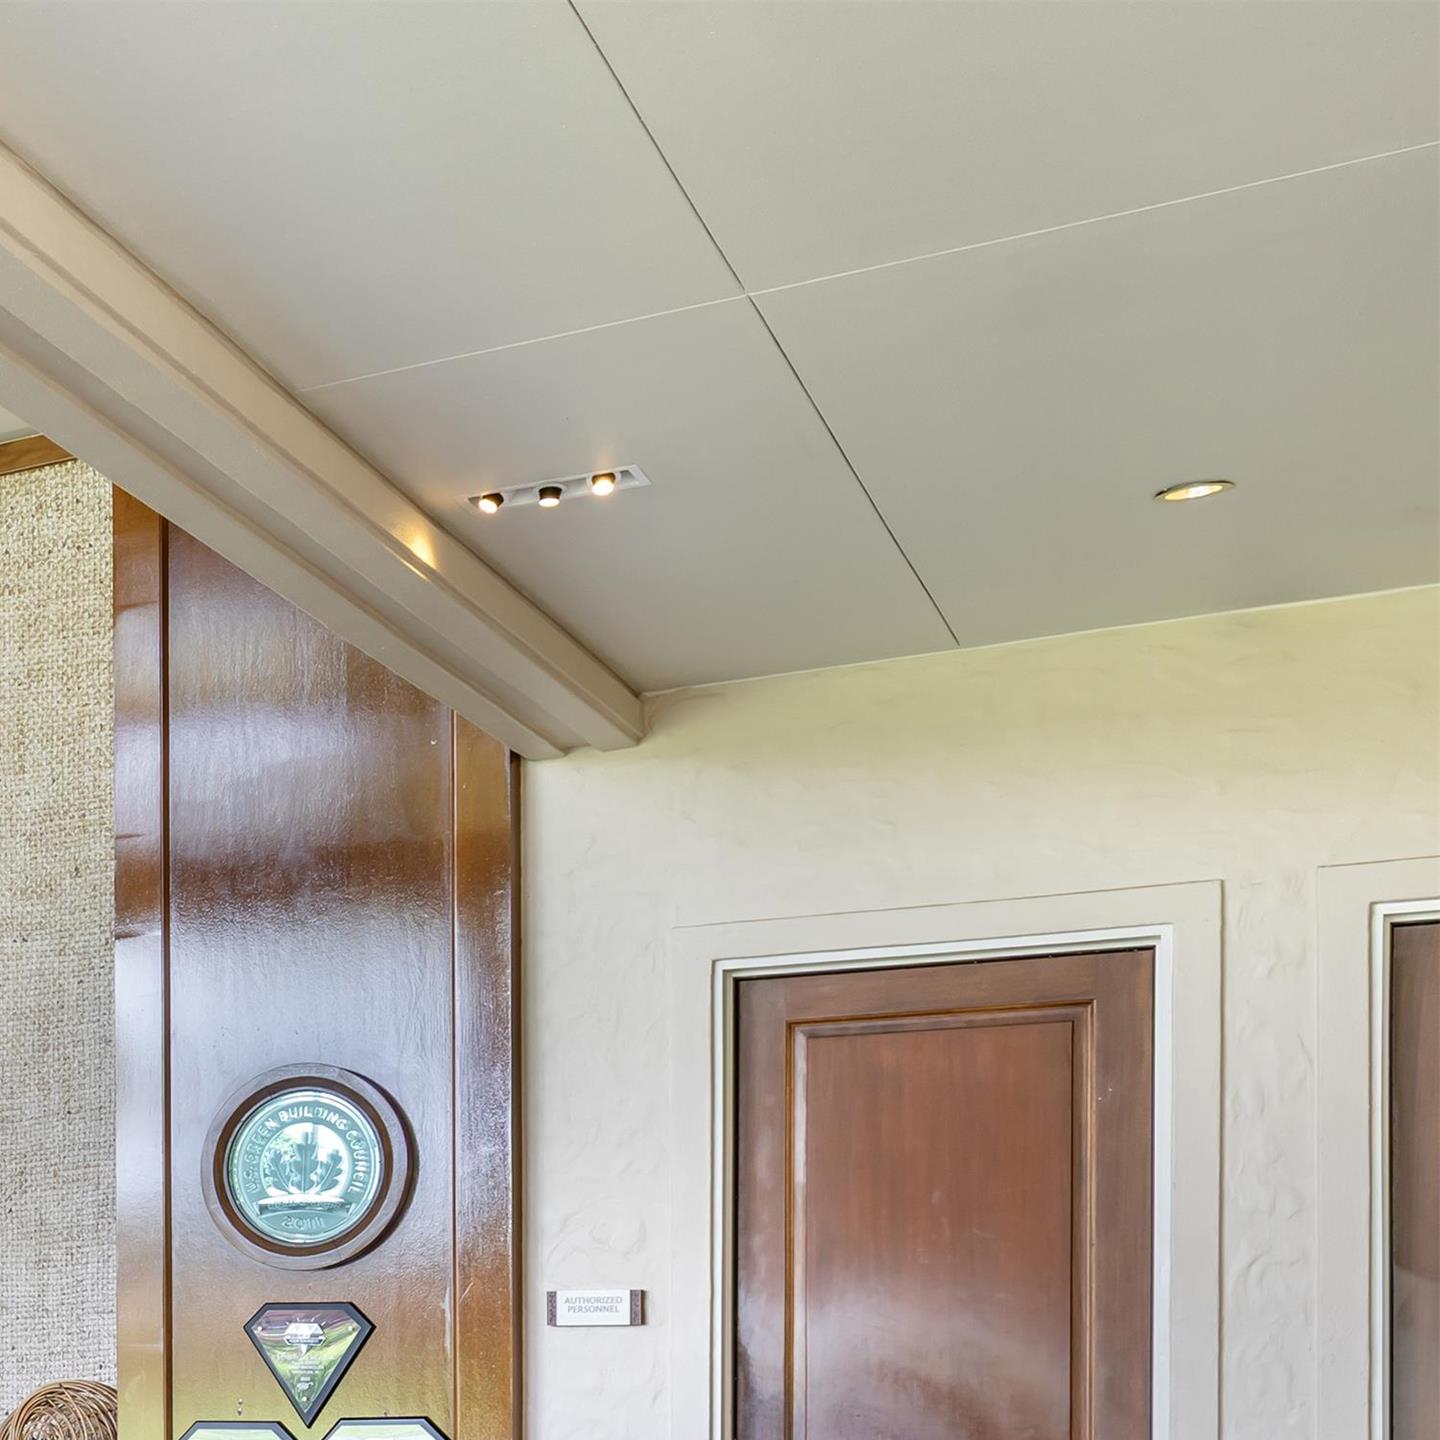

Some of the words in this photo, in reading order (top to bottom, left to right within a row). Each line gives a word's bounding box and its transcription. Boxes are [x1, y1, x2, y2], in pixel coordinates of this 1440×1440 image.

[278, 1106, 349, 1131] BUILDING
[345, 1130, 369, 1194] COUNCIL
[564, 1296, 623, 1304] AUTHORIZED
[567, 1305, 620, 1313] PERSONNEL
